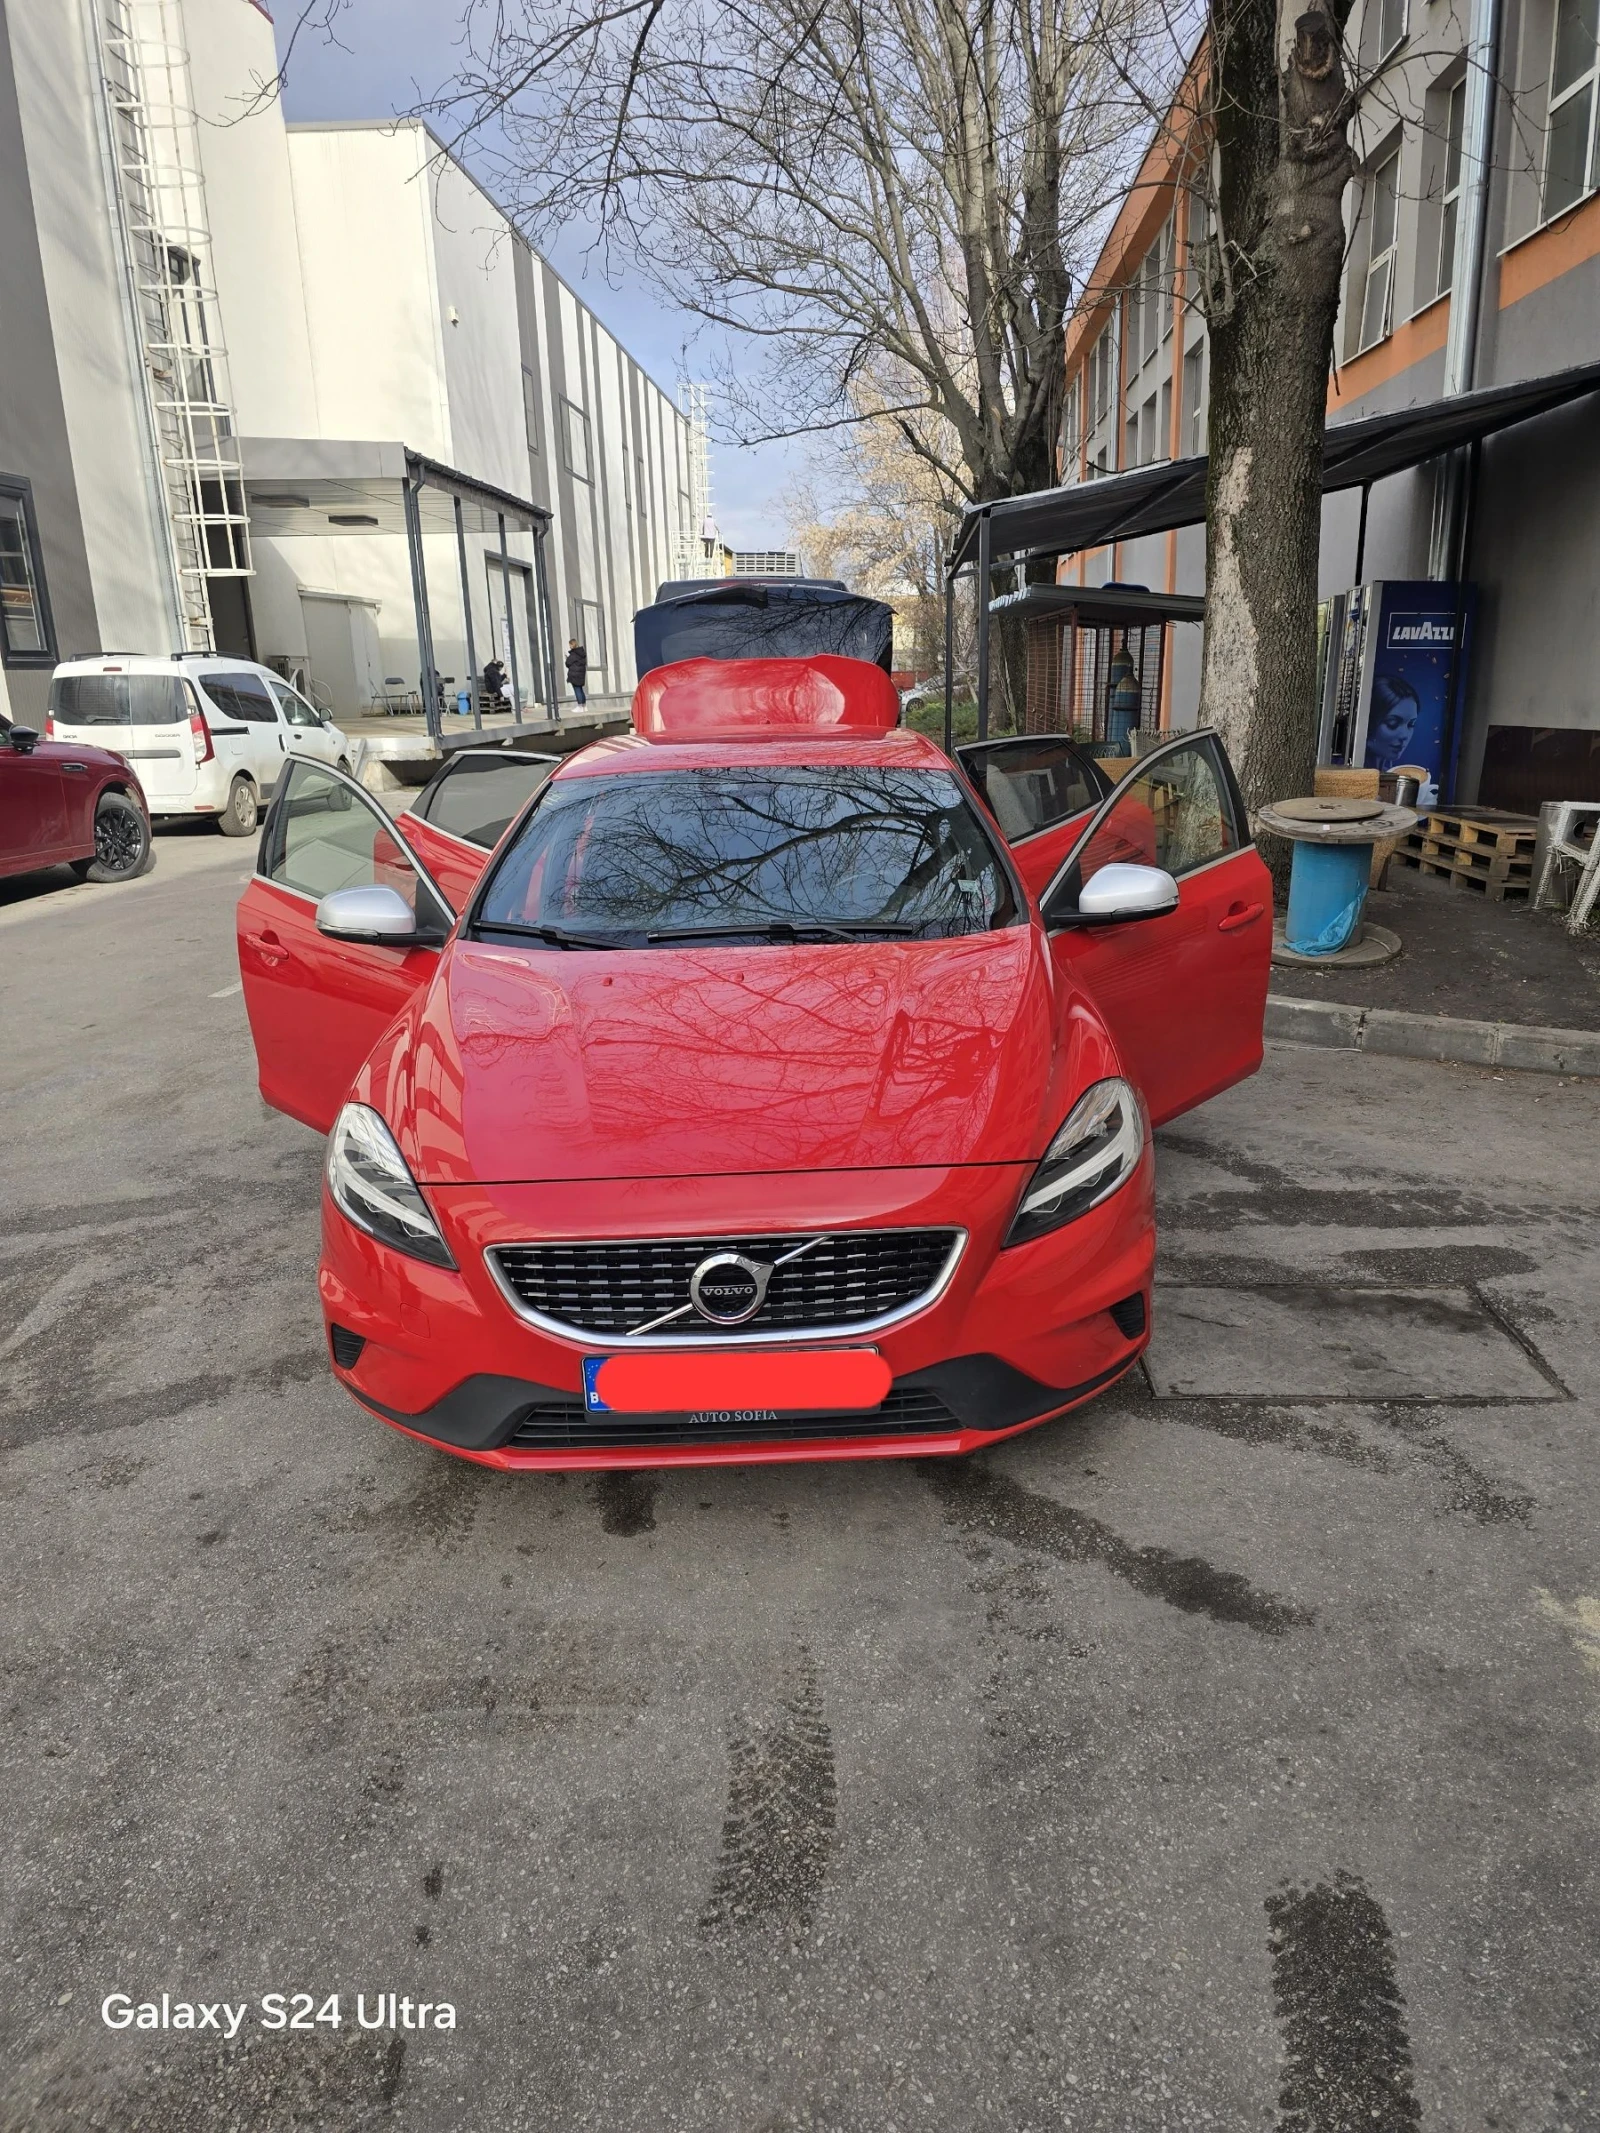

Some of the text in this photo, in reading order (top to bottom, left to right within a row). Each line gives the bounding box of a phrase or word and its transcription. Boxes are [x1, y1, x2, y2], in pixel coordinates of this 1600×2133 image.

[701, 1286, 754, 1296] VOLVO
[590, 1391, 600, 1404] B
[688, 1409, 778, 1424] AUTO SOFIA
